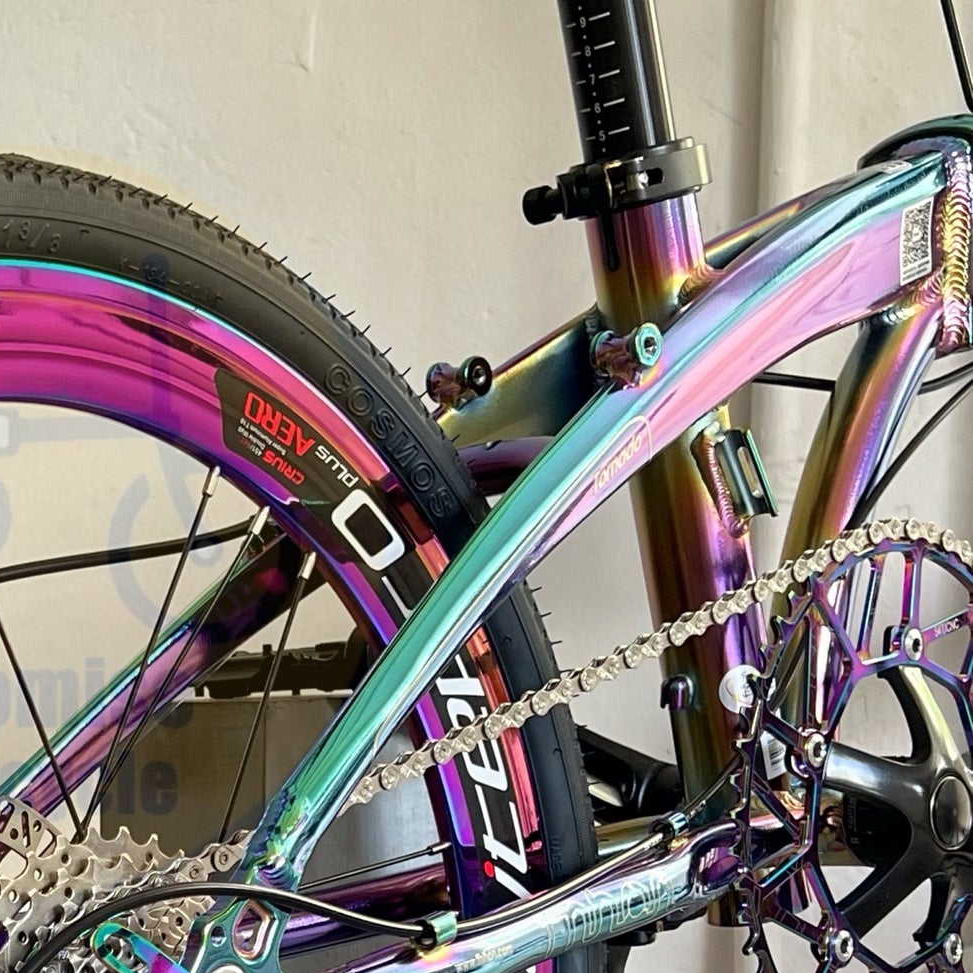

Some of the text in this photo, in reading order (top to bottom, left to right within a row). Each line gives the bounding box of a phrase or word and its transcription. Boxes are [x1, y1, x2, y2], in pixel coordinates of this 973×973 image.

[579, 16, 587, 28] 9
[584, 45, 592, 57] 8
[589, 73, 596, 85] 7
[594, 102, 601, 114] 6
[599, 130, 606, 141] 5
[244, 391, 315, 457] AERO
[327, 363, 453, 517] COSMOS
[263, 450, 304, 485] CRIUS
